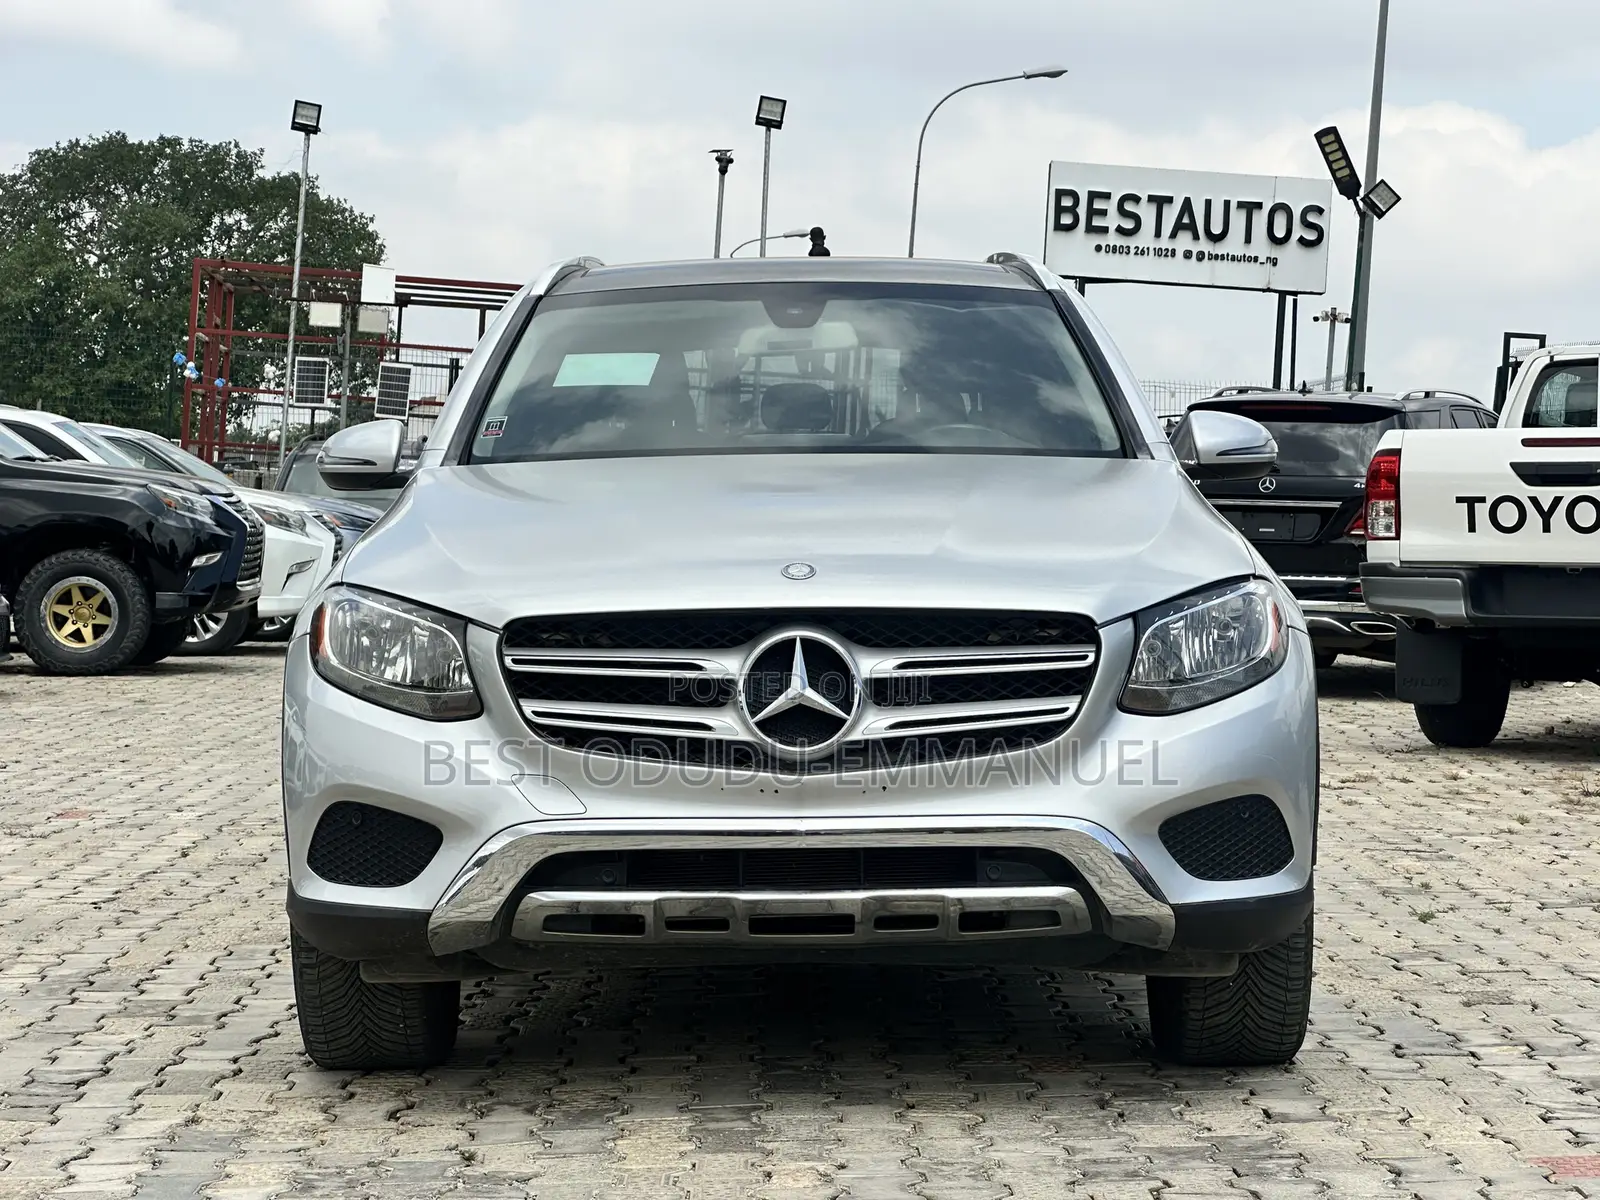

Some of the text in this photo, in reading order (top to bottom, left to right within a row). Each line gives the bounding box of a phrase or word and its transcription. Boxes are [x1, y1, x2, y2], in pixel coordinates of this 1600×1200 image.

[1053, 188, 1325, 248] BESTAUTOS
[1104, 244, 1131, 255] 0803
[1133, 246, 1150, 257] 261
[1153, 247, 1177, 258] 1028
[1456, 494, 1600, 535] TOYO
